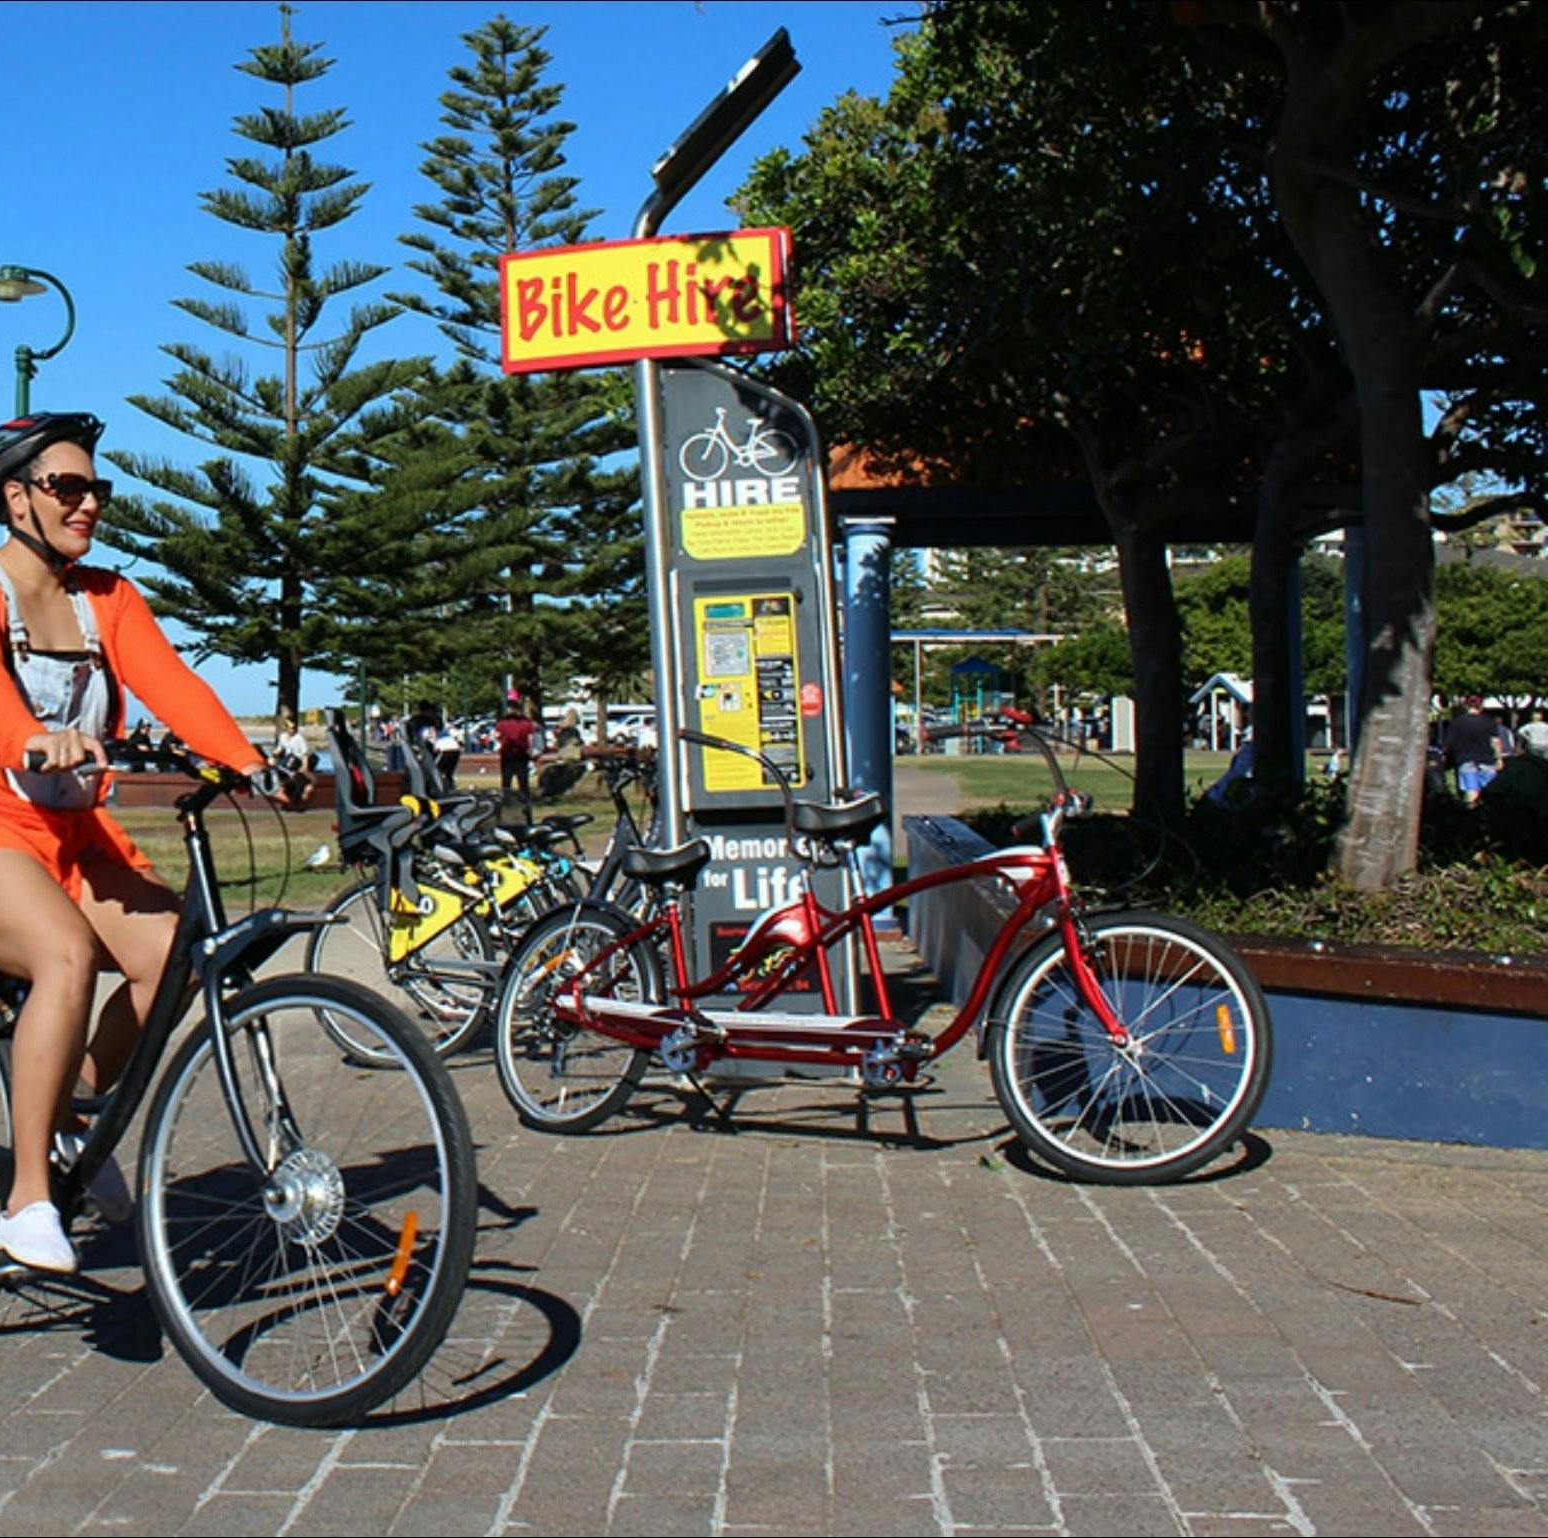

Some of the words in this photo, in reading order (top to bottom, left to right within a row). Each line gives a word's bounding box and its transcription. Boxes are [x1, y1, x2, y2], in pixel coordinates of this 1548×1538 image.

[517, 272, 630, 342] Bike
[646, 260, 763, 331] Hire
[683, 477, 802, 509] HIRE
[701, 834, 820, 861] Memore
[704, 869, 729, 888] for
